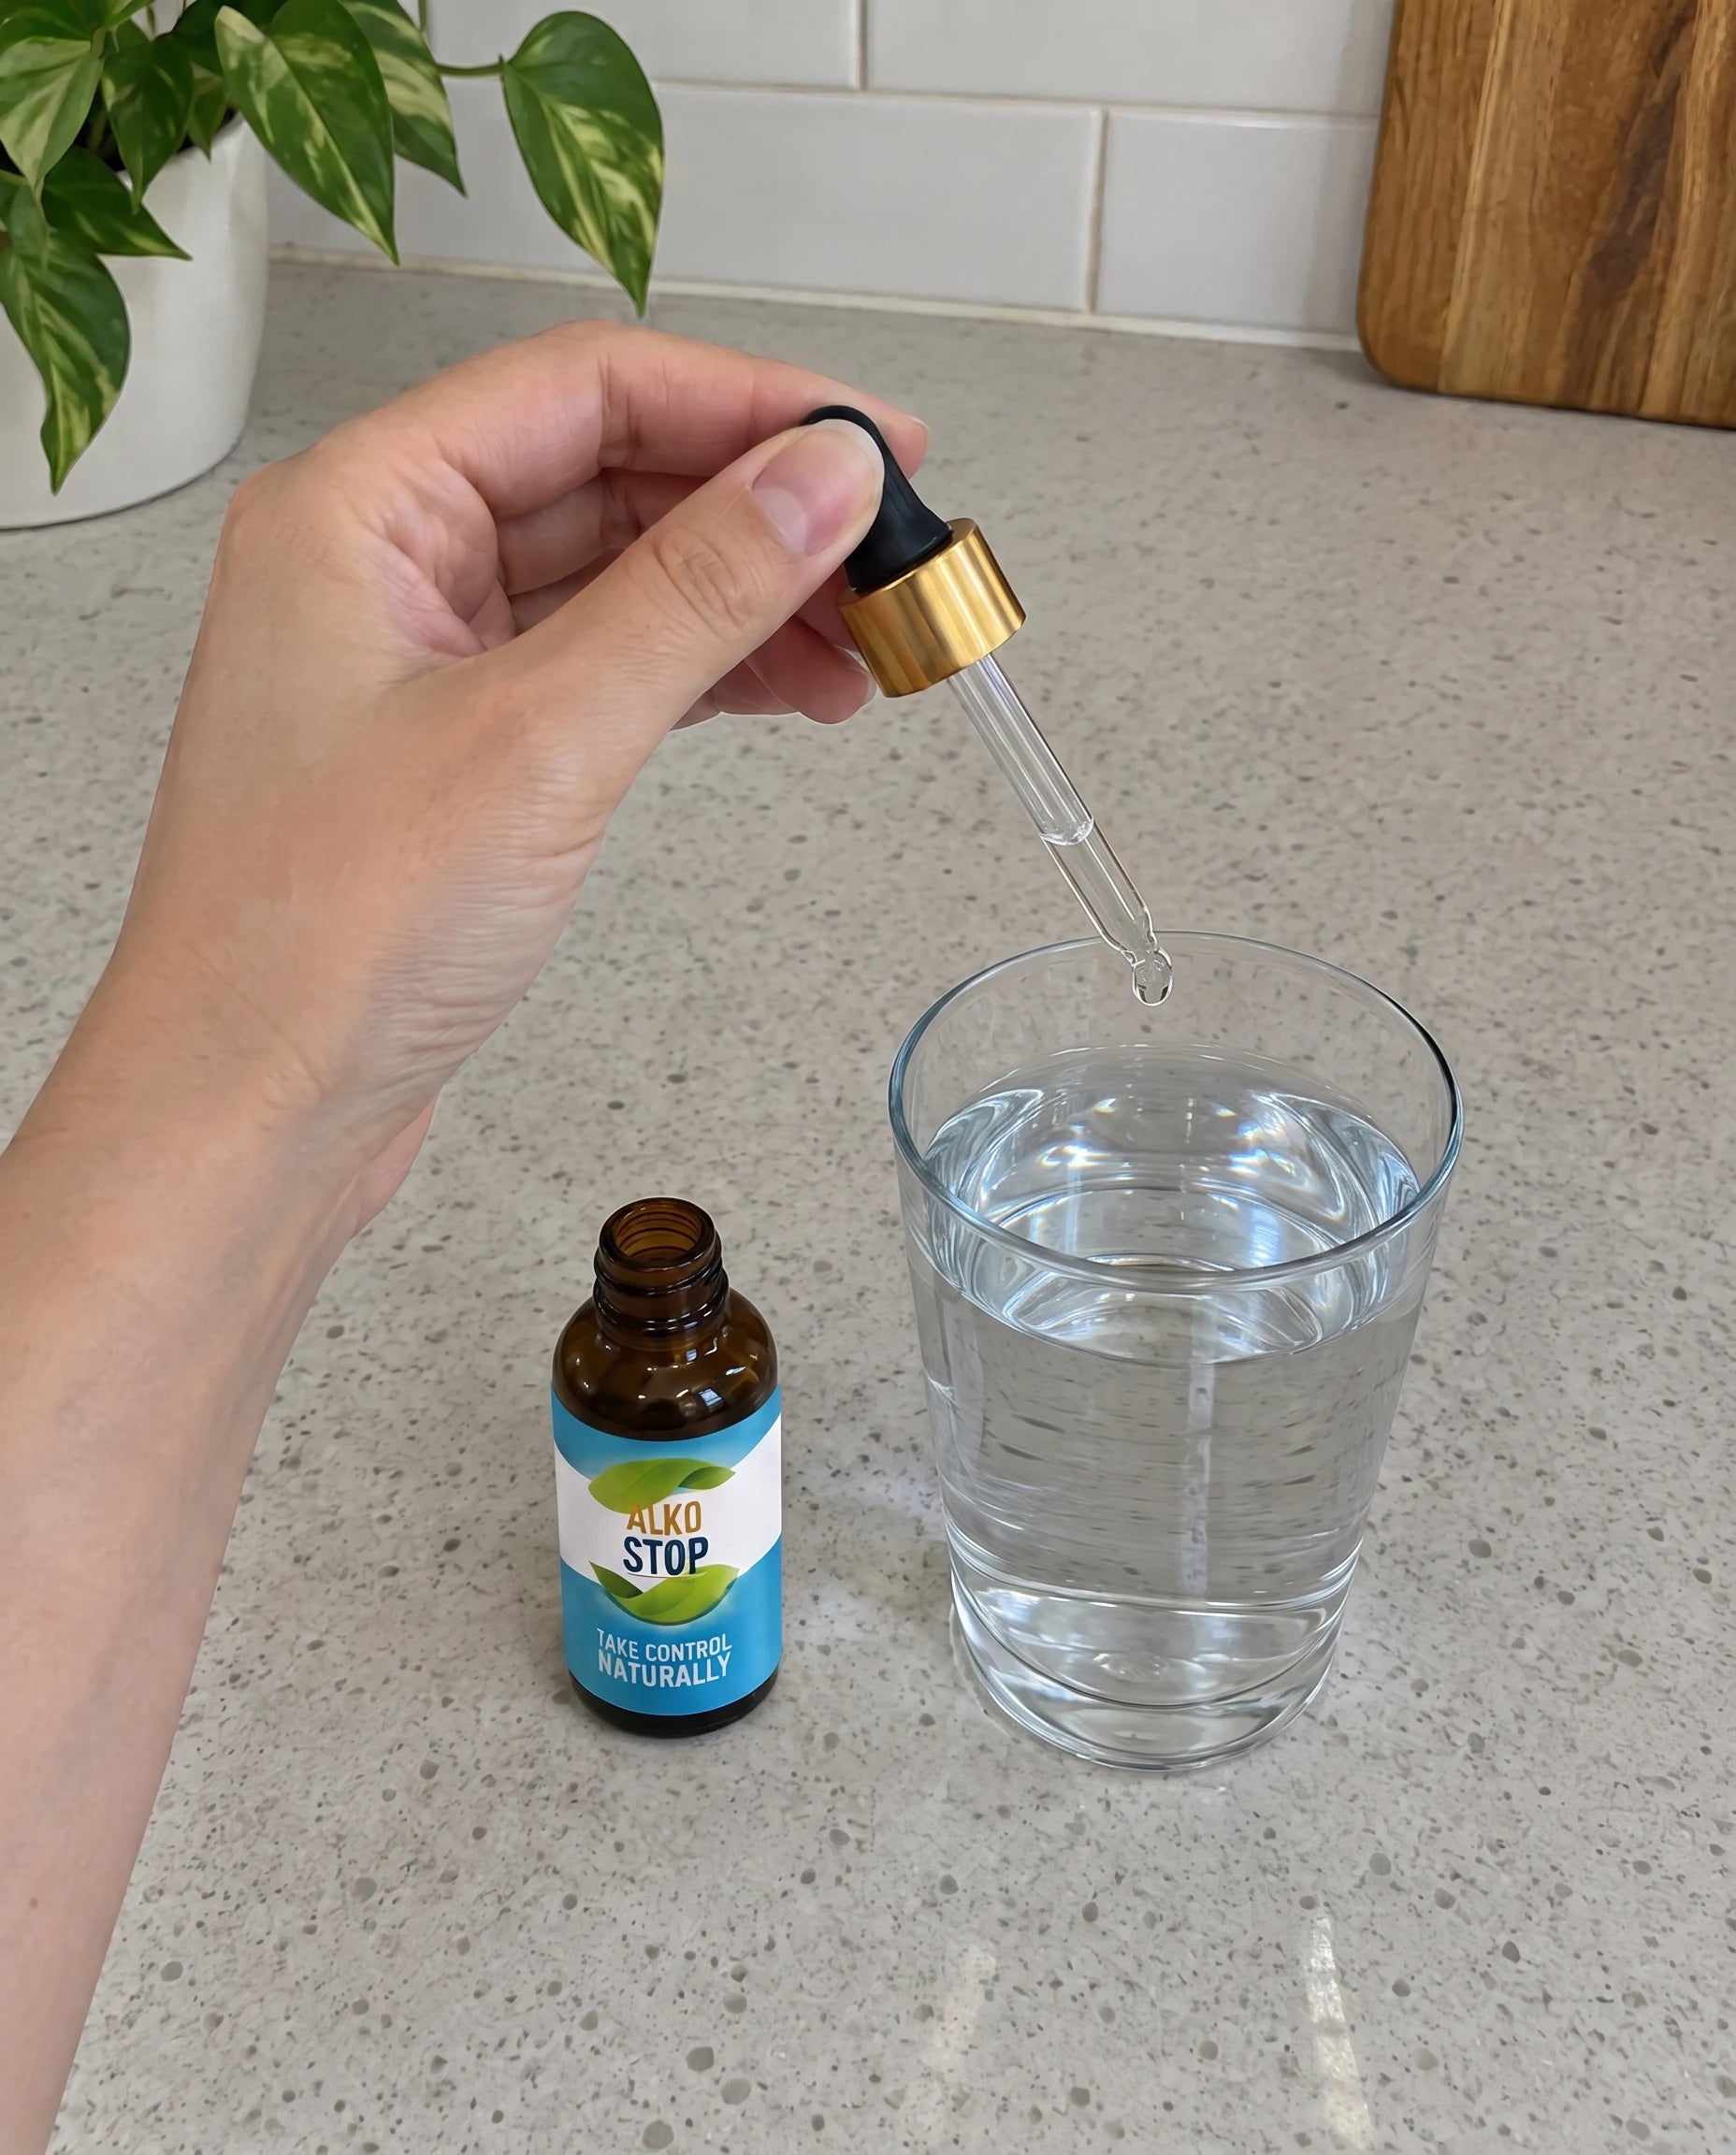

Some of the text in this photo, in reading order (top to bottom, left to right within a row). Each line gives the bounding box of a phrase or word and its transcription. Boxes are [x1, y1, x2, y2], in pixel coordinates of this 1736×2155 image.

[627, 1500, 702, 1536] ALKO
[623, 1536, 709, 1575] STOP
[597, 1627, 732, 1663] TAKE CONTROL
[598, 1648, 731, 1687] NATURALLY
